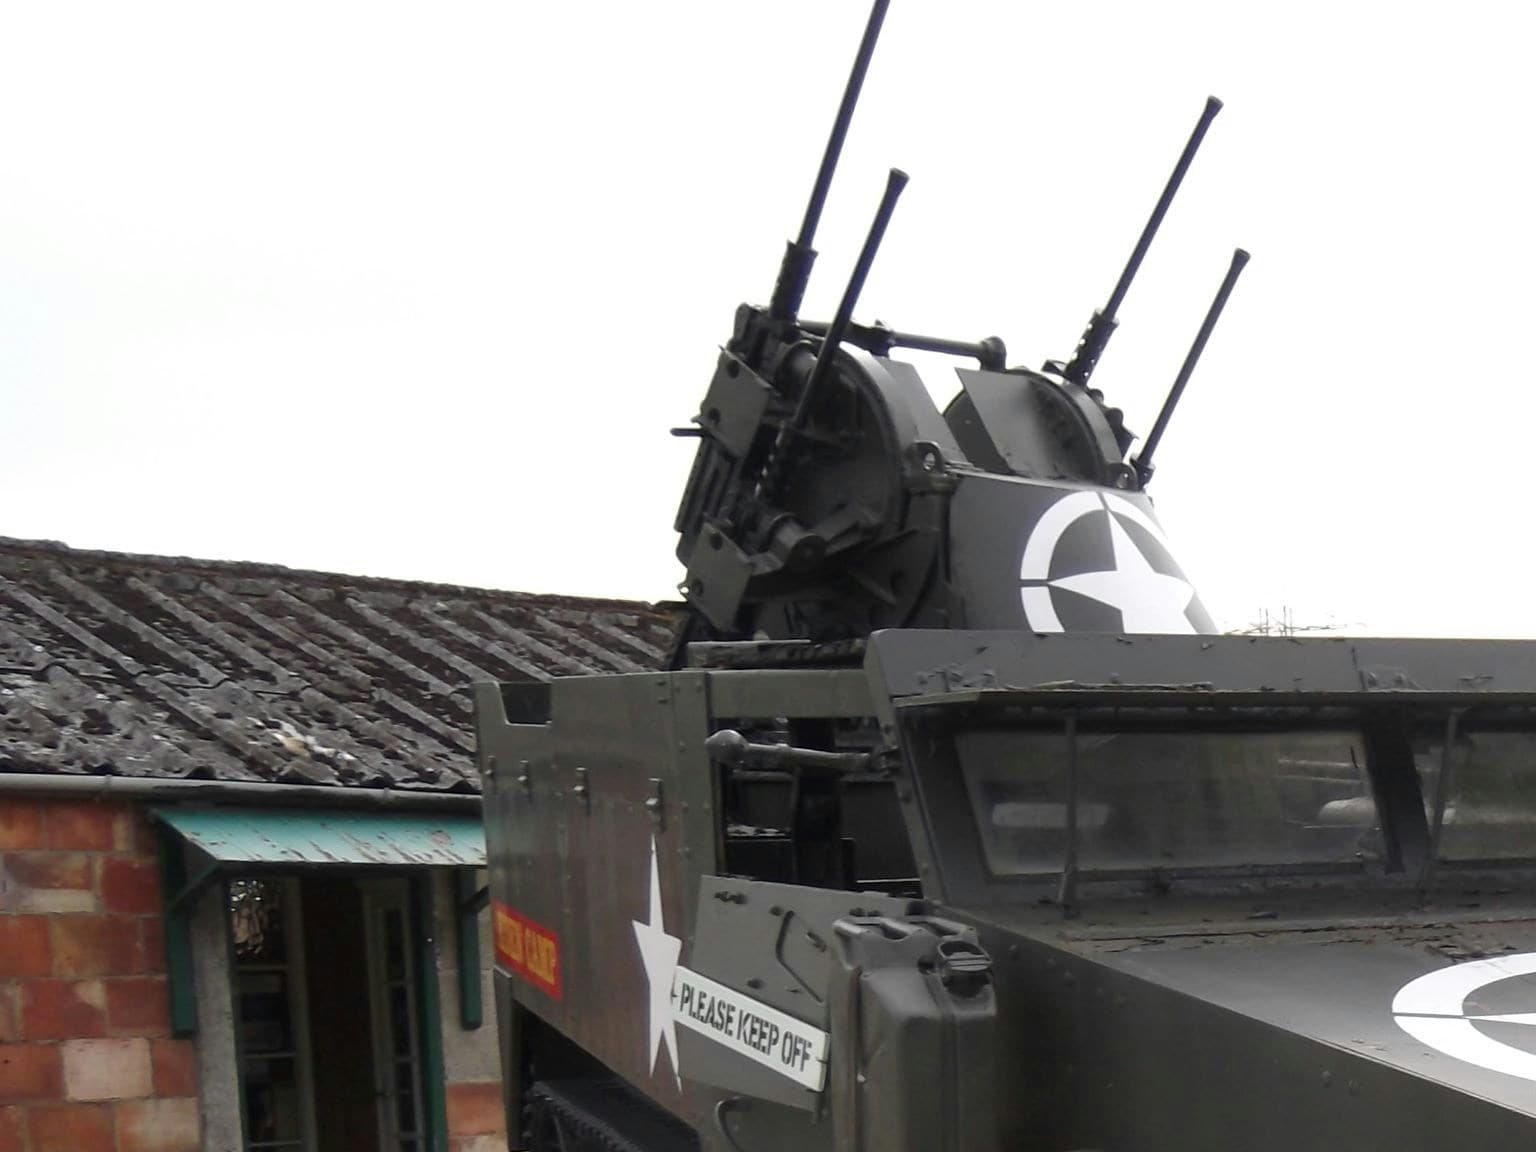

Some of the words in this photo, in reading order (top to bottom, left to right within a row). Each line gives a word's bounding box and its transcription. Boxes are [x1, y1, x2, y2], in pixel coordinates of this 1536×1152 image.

[680, 982, 736, 1037] PLEASE
[736, 1009, 780, 1056] KEEP
[781, 1030, 812, 1073] OFF
